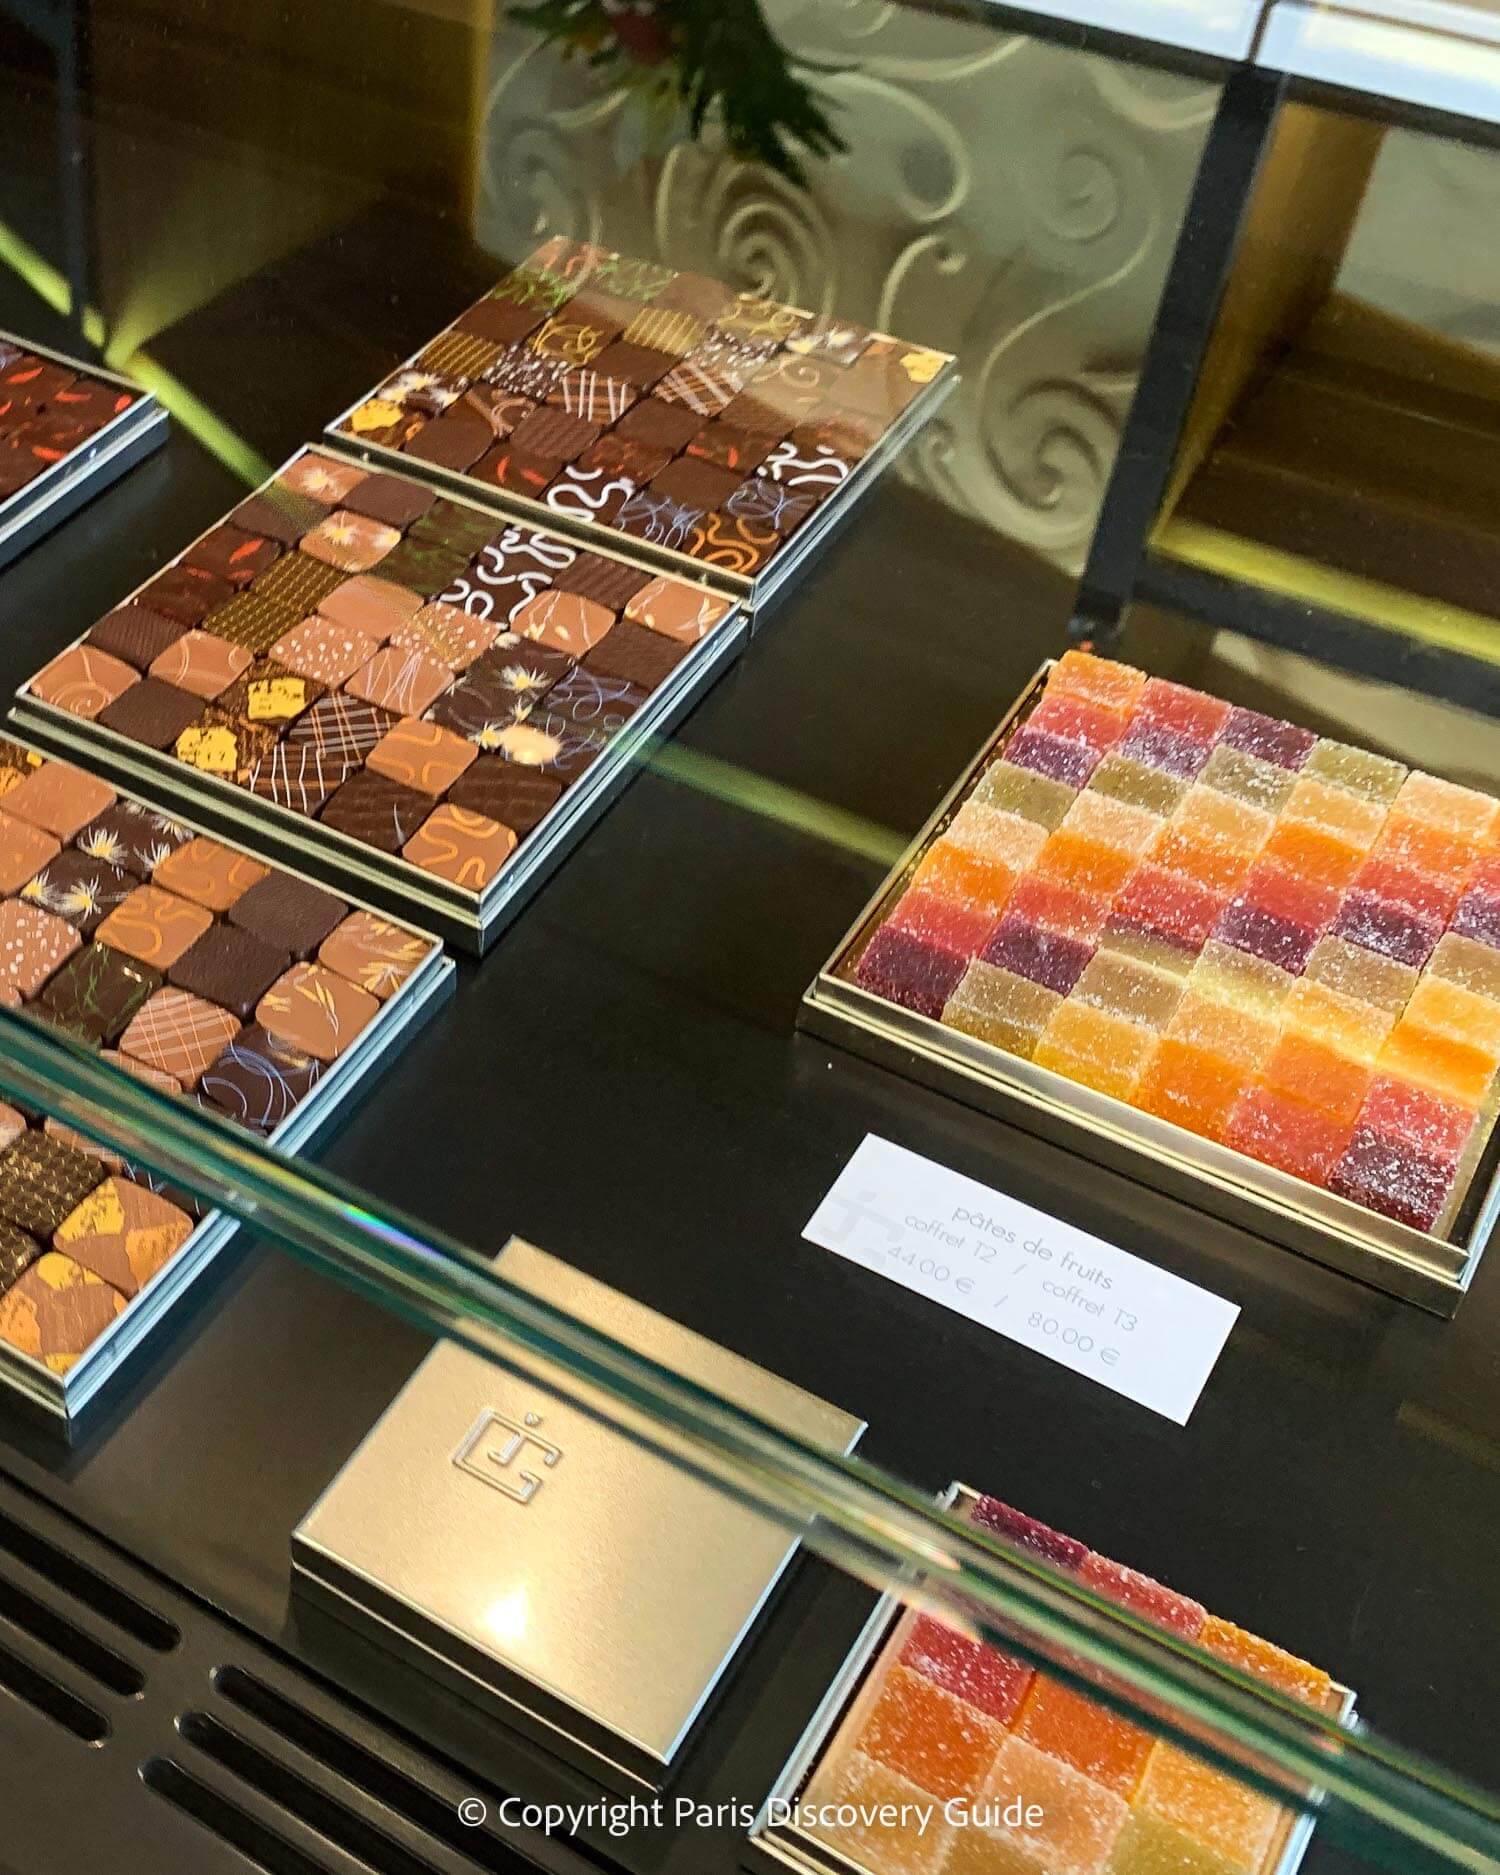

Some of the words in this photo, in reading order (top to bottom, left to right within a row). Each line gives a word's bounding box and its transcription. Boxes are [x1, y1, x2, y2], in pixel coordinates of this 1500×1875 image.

[887, 1245, 951, 1283] 44.00
[955, 1276, 977, 1296] €
[1027, 1311, 1095, 1353] 80.00
[1100, 1347, 1121, 1367] €
[904, 1215, 966, 1249] coffret
[972, 1239, 998, 1264] T2
[1042, 1279, 1106, 1318] coffret
[1113, 1307, 1139, 1332] T3
[951, 1206, 1017, 1244] pâtes
[1022, 1237, 1053, 1261] de
[1059, 1250, 1113, 1290] fruits
